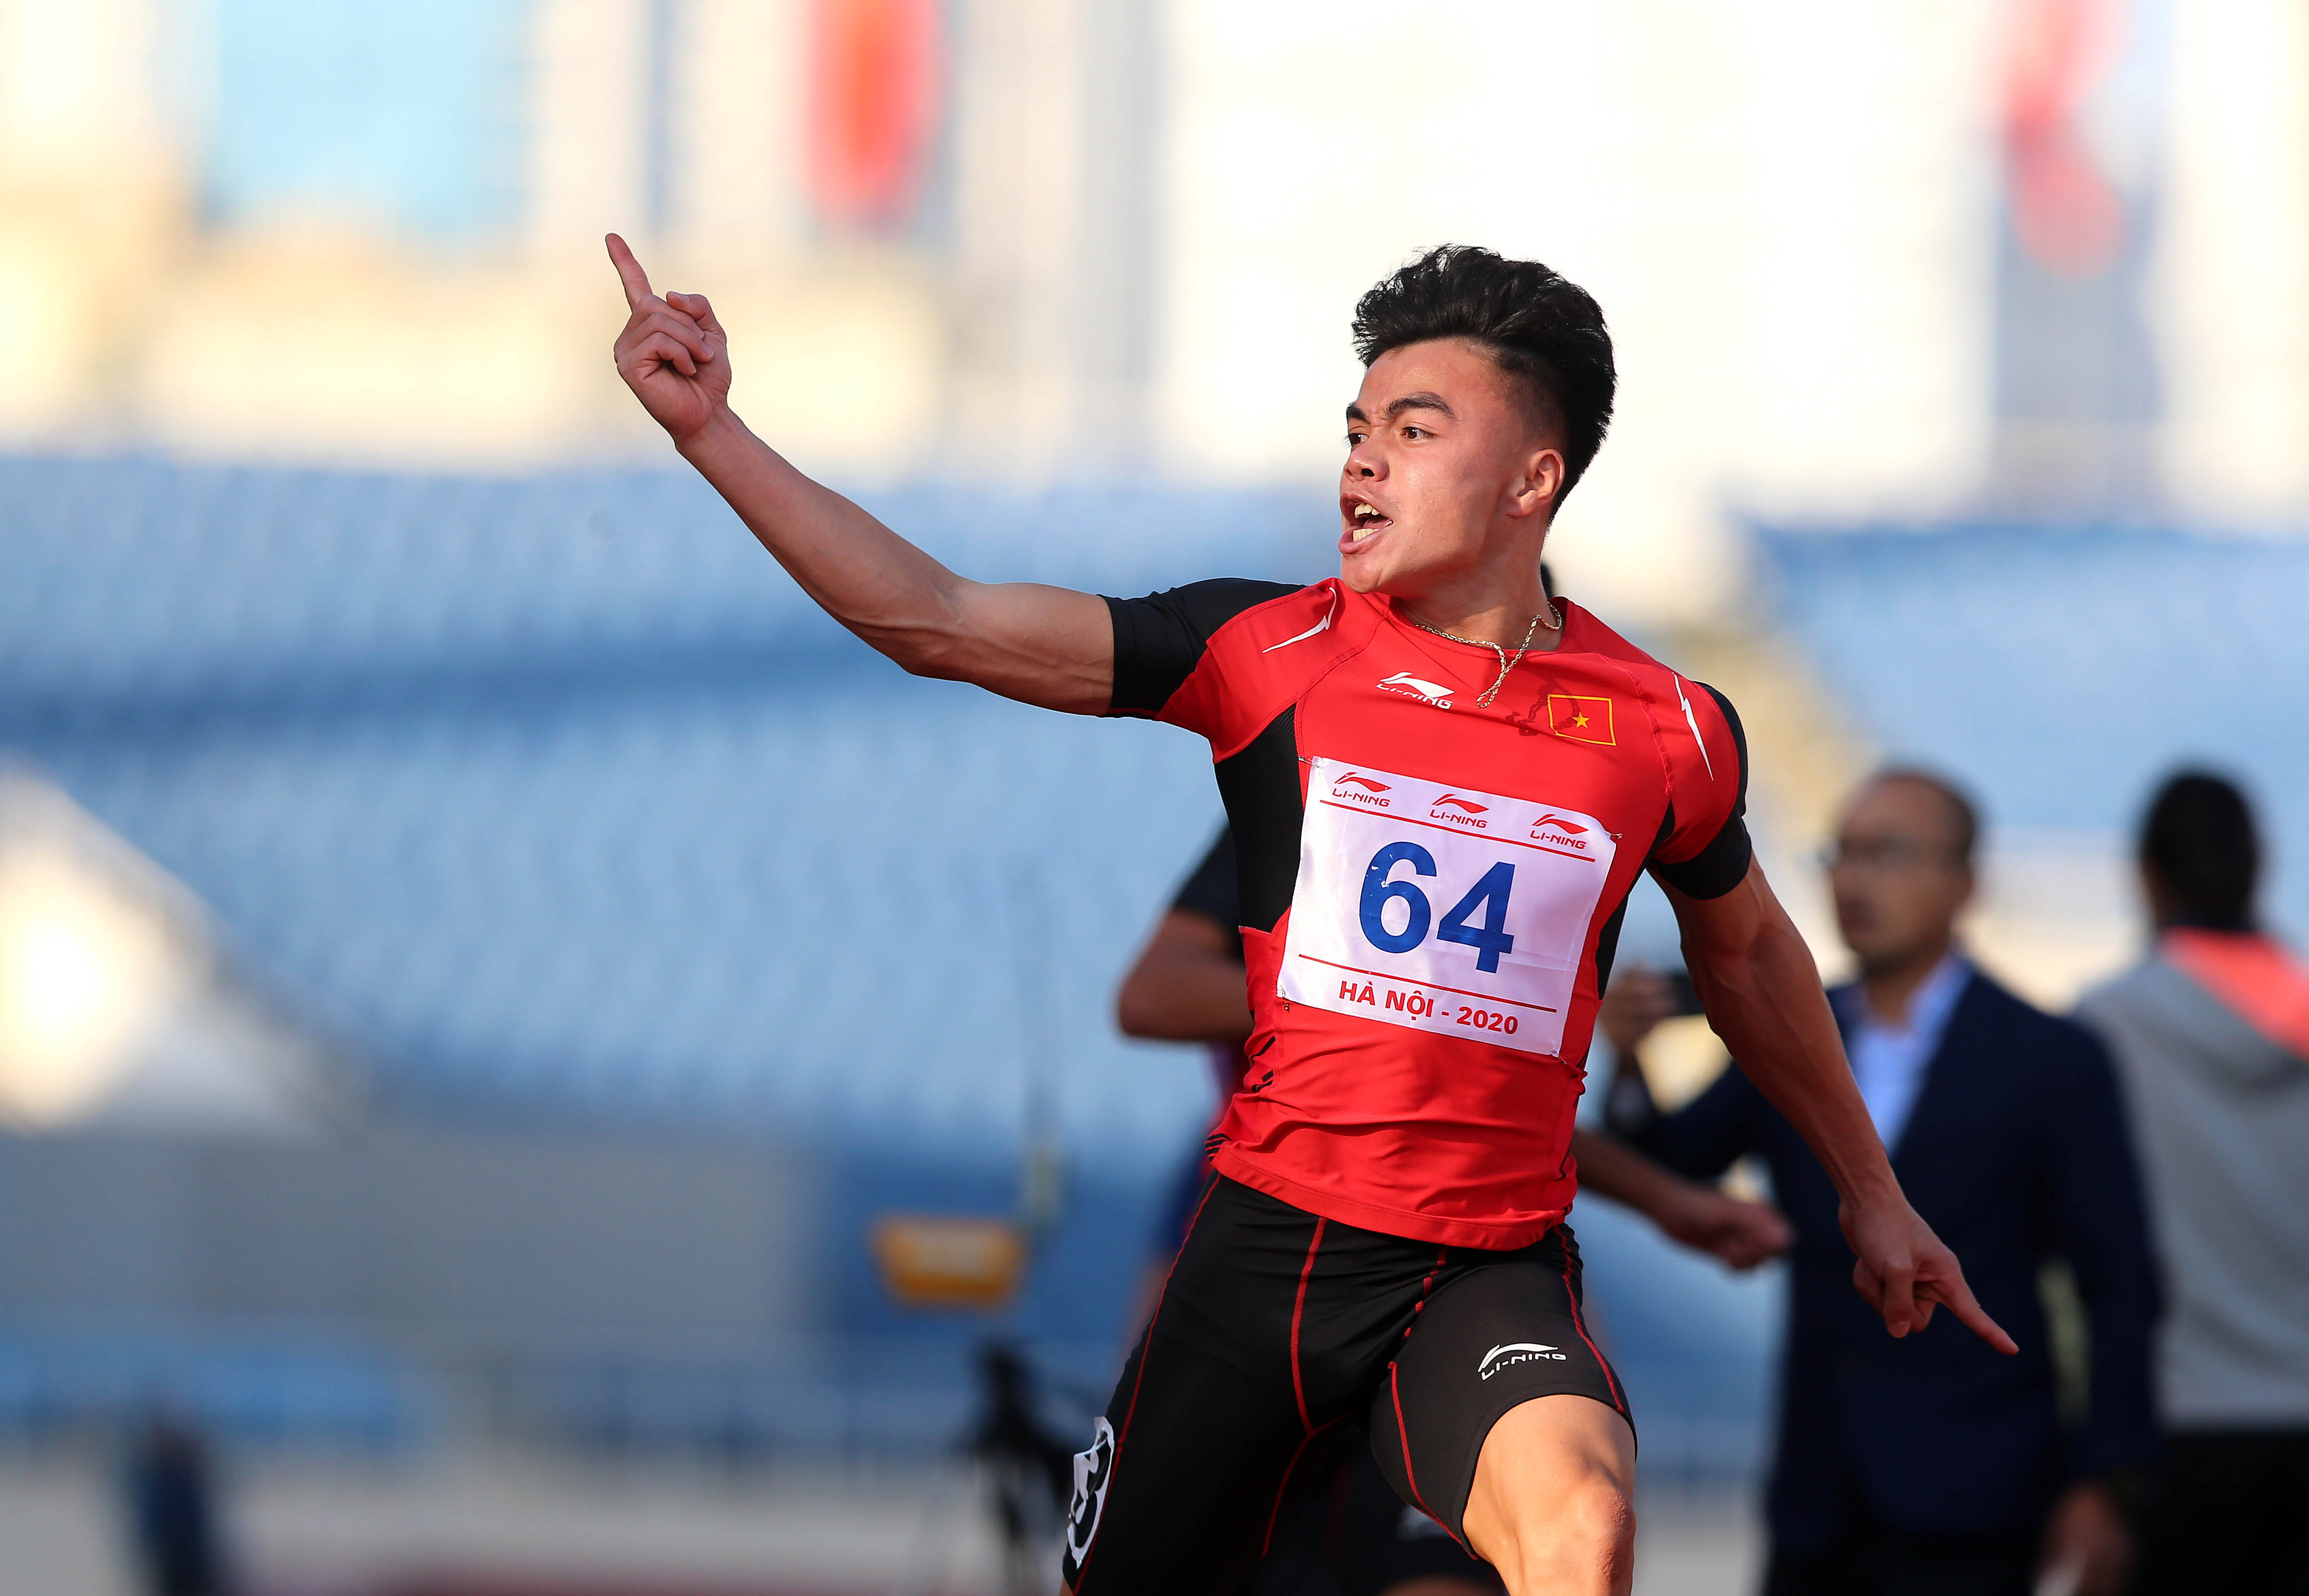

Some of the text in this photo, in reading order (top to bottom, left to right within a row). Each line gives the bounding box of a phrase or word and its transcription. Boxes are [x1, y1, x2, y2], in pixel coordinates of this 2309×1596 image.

[1376, 683, 1453, 709] LI-NING
[1332, 788, 1391, 807] LI-NING
[1430, 809, 1488, 828] LI-NING
[1530, 830, 1586, 850] LI-NING
[1359, 841, 1516, 973] 64
[1339, 979, 1376, 1006] HÀ
[1385, 990, 1434, 1021] NỘI
[1456, 1006, 1518, 1034] 2020
[1481, 1353, 1567, 1380] LI-NING
